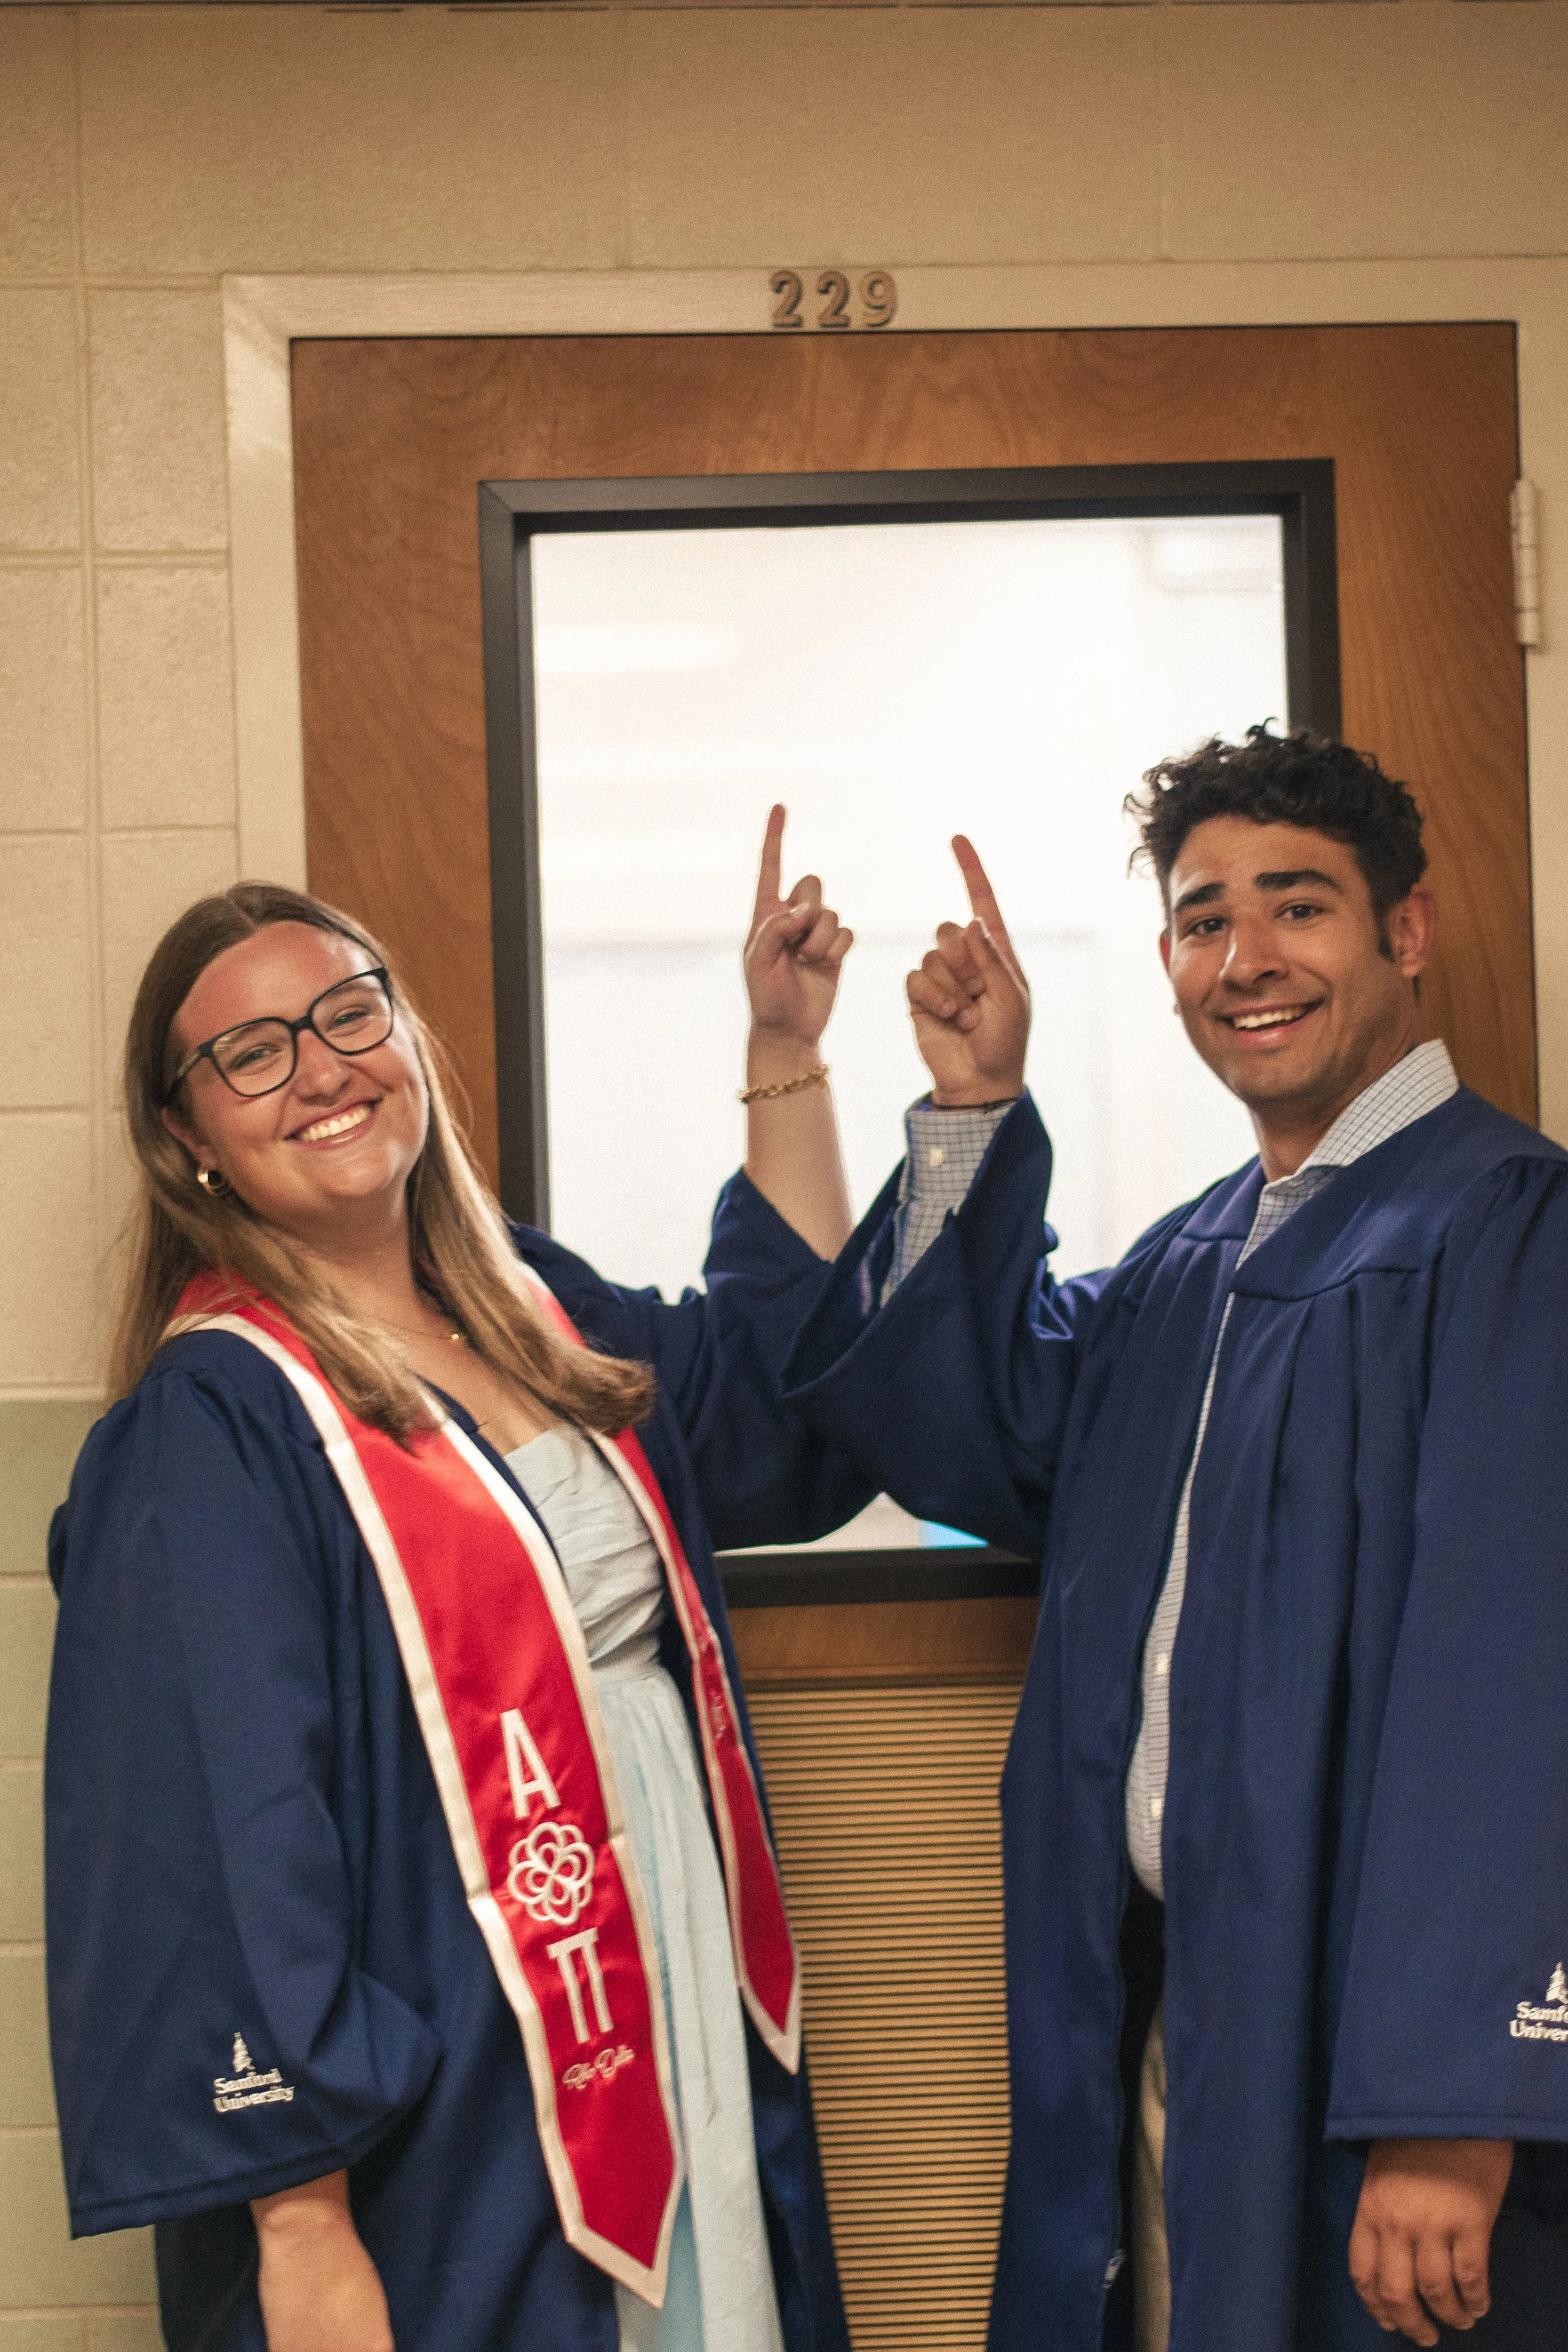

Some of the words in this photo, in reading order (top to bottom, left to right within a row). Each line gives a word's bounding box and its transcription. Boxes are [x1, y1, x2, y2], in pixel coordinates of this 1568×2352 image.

[769, 270, 897, 328] 229
[500, 1708, 561, 1818] A
[213, 2086, 295, 2112] University
